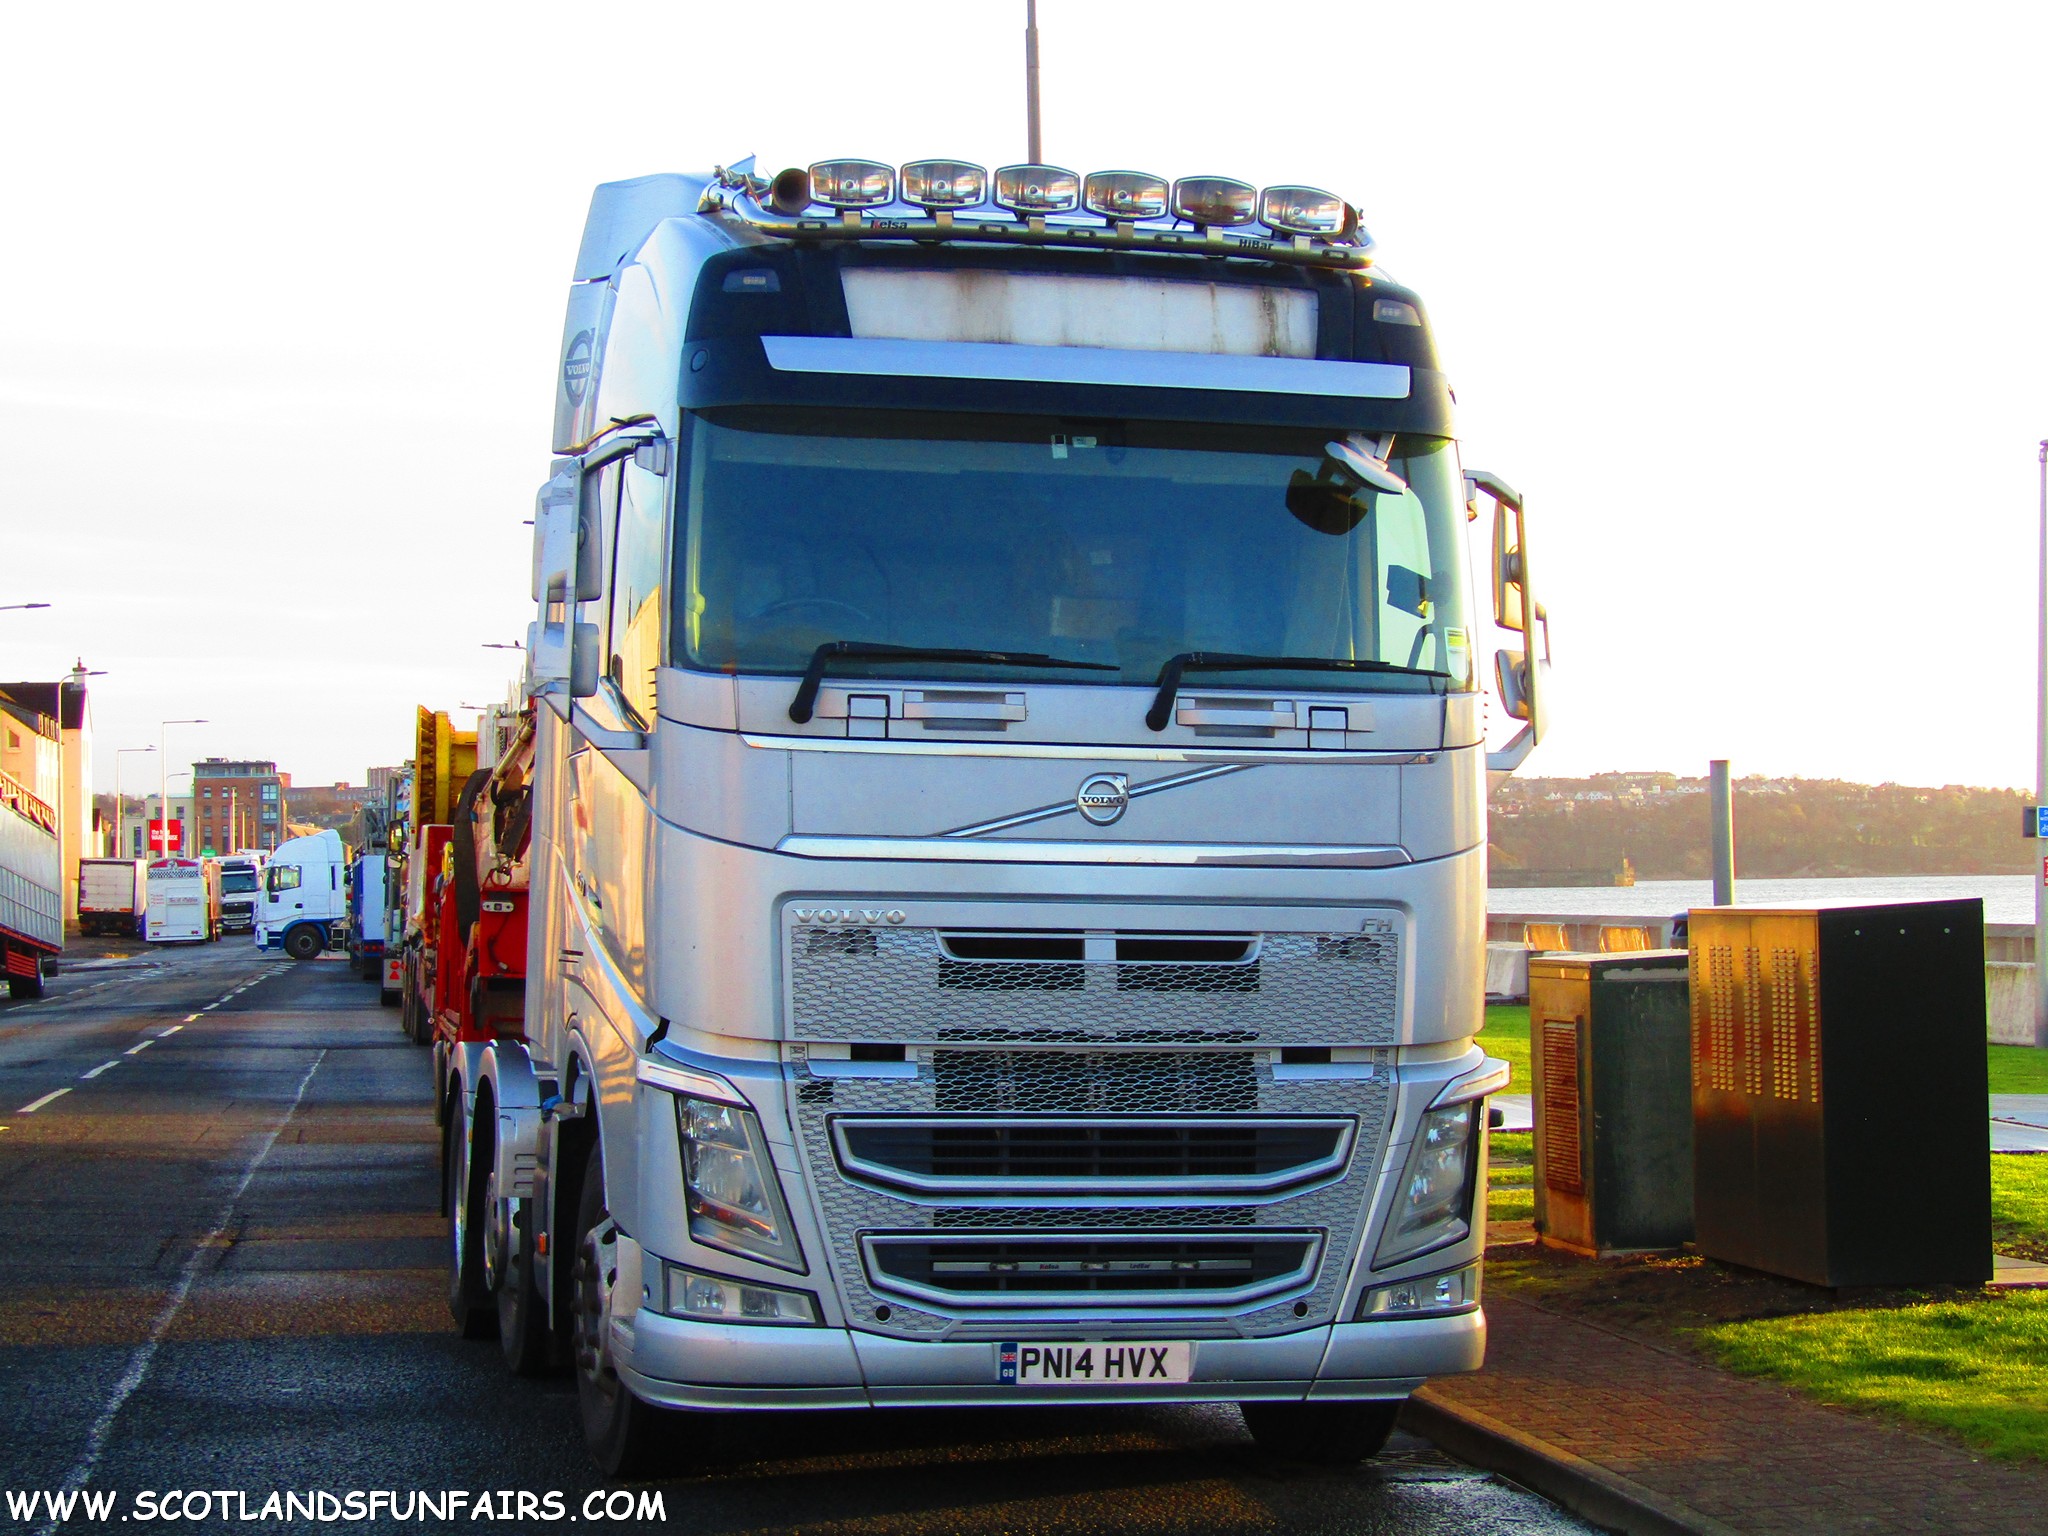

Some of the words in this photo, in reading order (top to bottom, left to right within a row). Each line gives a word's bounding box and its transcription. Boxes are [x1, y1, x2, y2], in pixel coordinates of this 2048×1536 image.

[870, 219, 908, 230] Kelsa
[1239, 239, 1274, 250] HiBar
[566, 363, 590, 375] VOLVO
[1080, 796, 1125, 804] VOLVO
[792, 908, 906, 924] VOLVO
[1361, 918, 1393, 932] FH
[1020, 1347, 1094, 1378] PN14
[1105, 1347, 1168, 1378] HVX
[1002, 1368, 1015, 1378] GB
